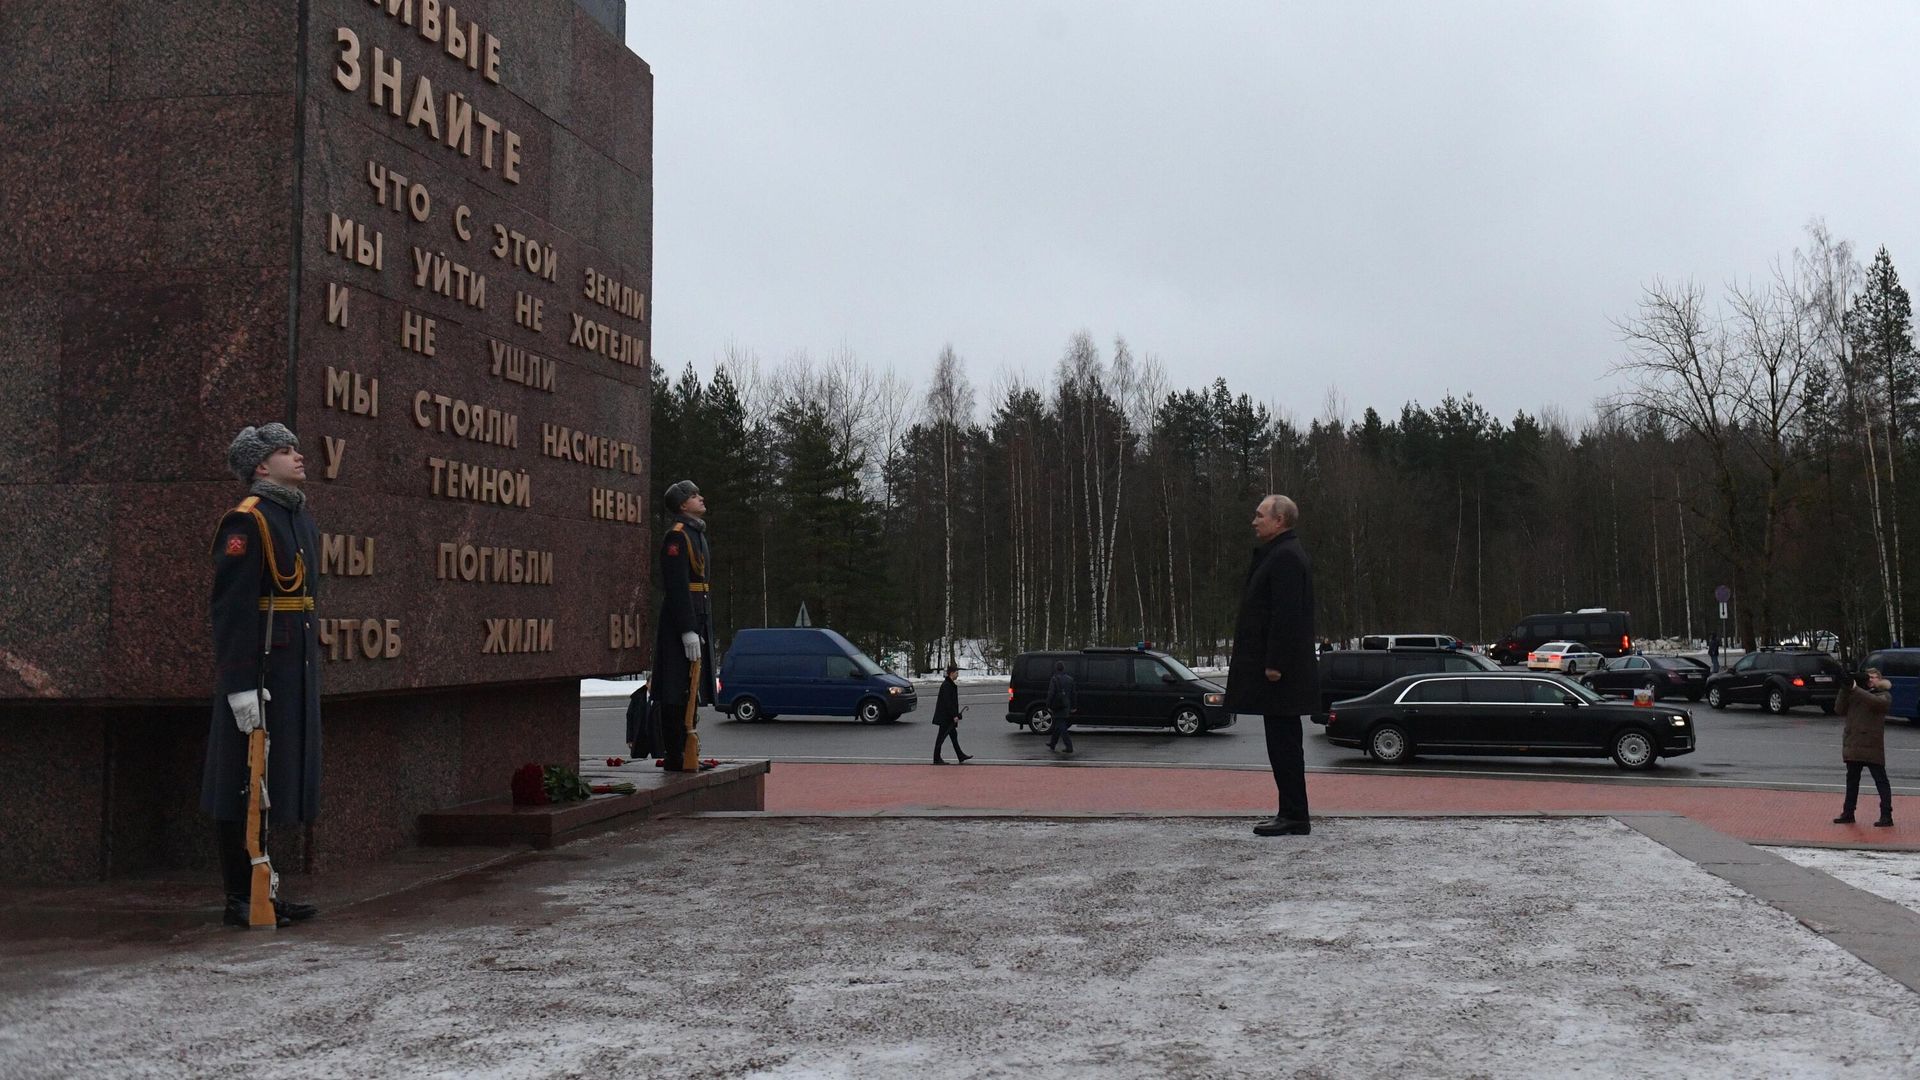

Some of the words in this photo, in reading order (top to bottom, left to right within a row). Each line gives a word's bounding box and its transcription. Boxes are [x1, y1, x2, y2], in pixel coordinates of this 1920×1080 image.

[370, 0, 500, 84] ИВЫЕ
[332, 27, 521, 184] ЗНАЙТЕ
[328, 213, 382, 270] МЫ
[413, 247, 485, 309] УЙТИ
[515, 291, 543, 332] НЕ
[569, 312, 644, 368] ХОТЕЛИ
[368, 160, 430, 222] ЧТО
[455, 205, 471, 241] С
[492, 223, 557, 282] ЭТОЙ
[584, 267, 644, 321] ЗЕМЛИ
[327, 282, 348, 328] И
[402, 310, 436, 356] НЕ
[490, 340, 556, 393] УШЛИ
[325, 366, 378, 417] МЫ
[412, 390, 518, 449] СТОЯЛИ
[541, 423, 643, 475] НАСМЕРТЬ
[324, 436, 346, 479] У
[429, 457, 531, 508] ТЕМНОЙ
[592, 487, 643, 523] НЕВЫ
[320, 533, 374, 576] МЫ
[436, 543, 553, 585] ПОГИБЛИ
[318, 618, 402, 661] ЧТОБ
[481, 618, 553, 654] ЖИЛИ
[610, 614, 641, 649] ВЫ
